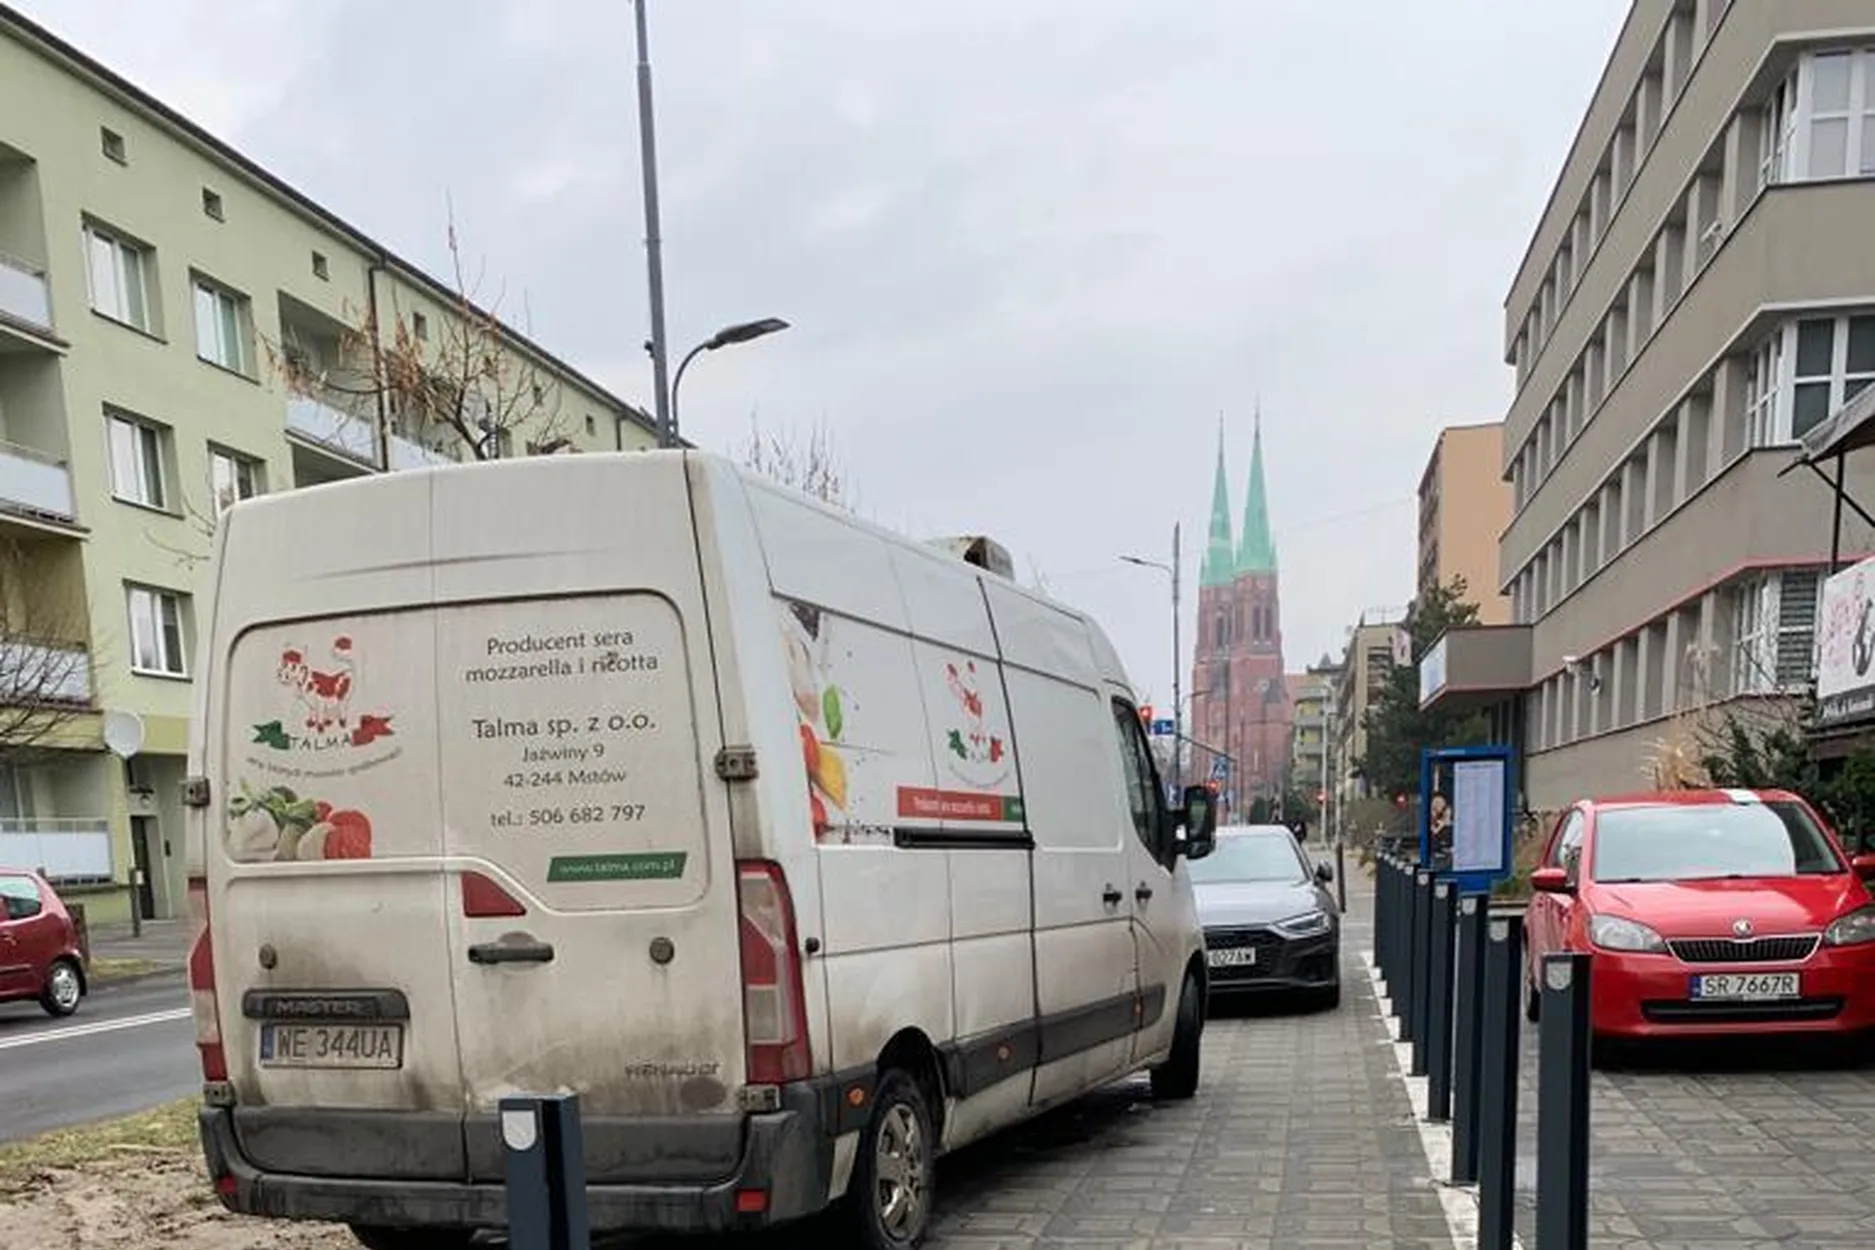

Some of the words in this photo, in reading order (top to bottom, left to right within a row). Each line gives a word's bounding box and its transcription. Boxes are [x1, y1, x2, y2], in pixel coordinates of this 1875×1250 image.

[487, 633, 587, 655] Producent
[593, 631, 636, 646] sera
[466, 659, 574, 683] mozzarella
[579, 657, 586, 675] i
[592, 654, 660, 674] ricotta
[471, 718, 539, 739] Talma
[548, 718, 580, 739] sp.
[588, 717, 601, 732] z
[609, 714, 658, 732] o.o.
[290, 735, 352, 752] TALMA
[593, 741, 605, 759] 9
[503, 770, 562, 788] 42-244
[568, 768, 626, 785] Mstów
[528, 807, 564, 826] 506
[569, 805, 604, 824] 682
[610, 804, 646, 822] 797
[559, 857, 675, 873] www.talma.com.pl
[1704, 976, 1729, 995] SR
[1737, 974, 1794, 993] 7667R
[278, 1028, 308, 1057] WE
[315, 1029, 393, 1058] 344UA
